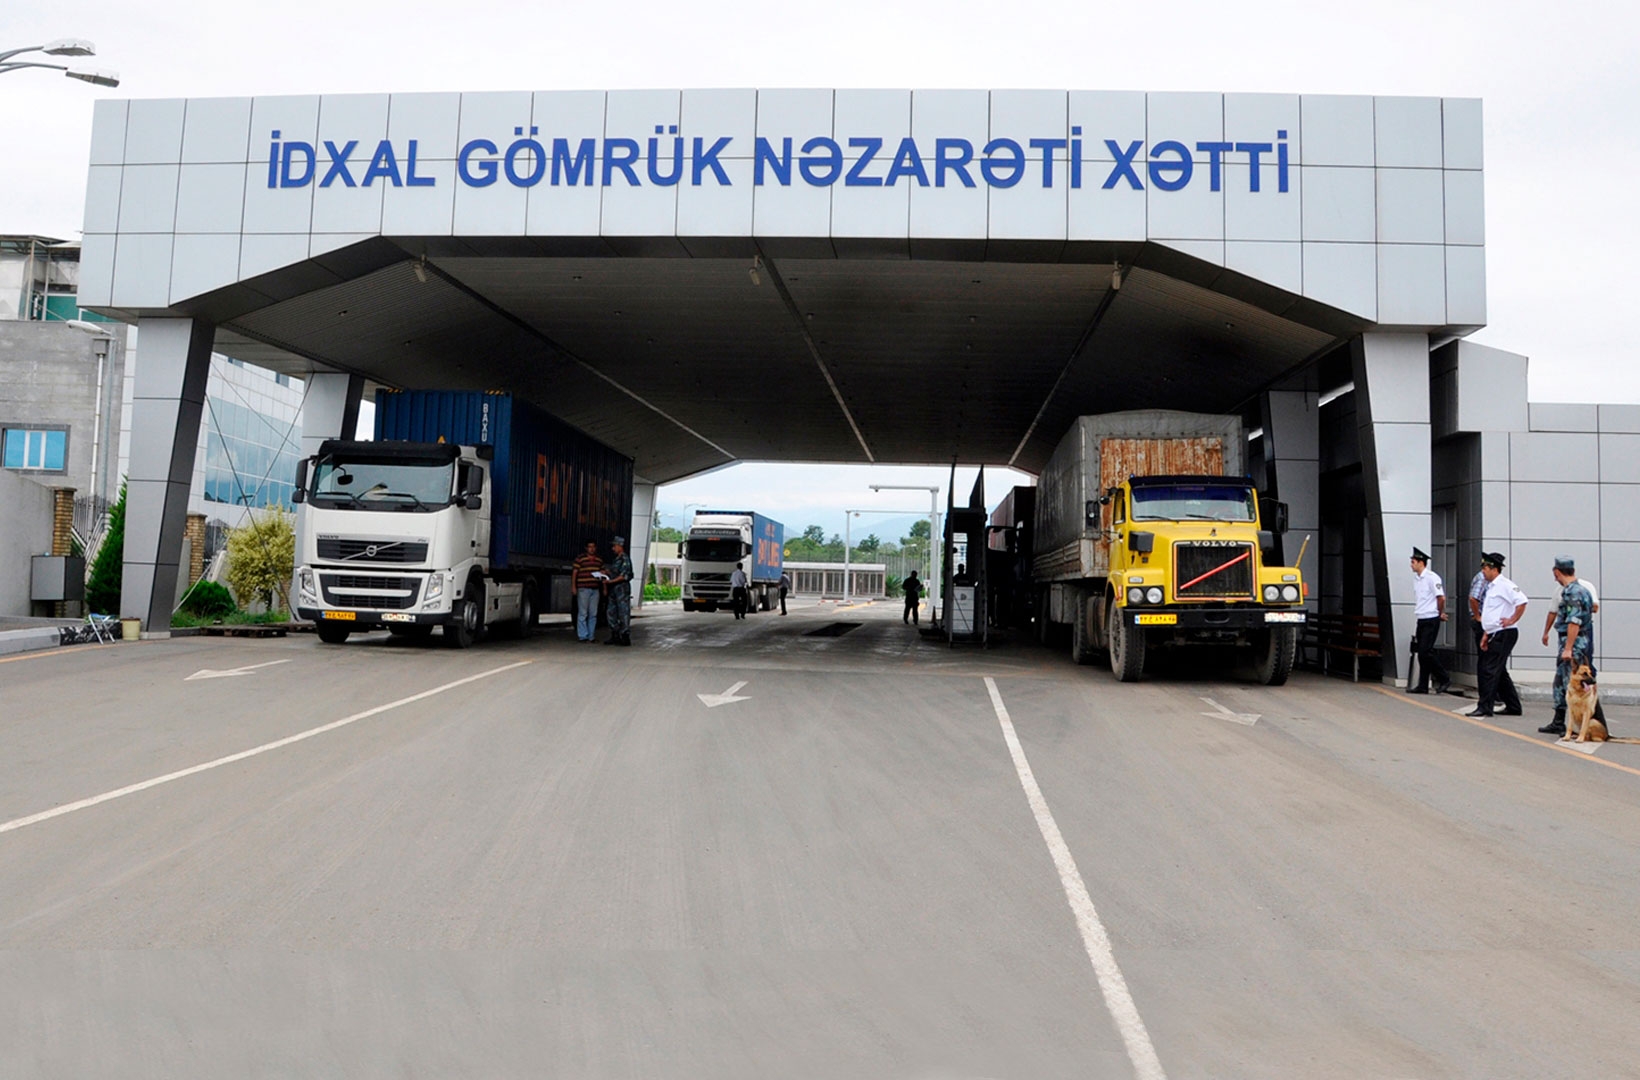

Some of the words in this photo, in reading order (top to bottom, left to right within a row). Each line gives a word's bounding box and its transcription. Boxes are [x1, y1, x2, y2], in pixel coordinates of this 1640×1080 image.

[268, 130, 435, 188] İDXAL
[457, 126, 733, 187] GÖMRÜK
[753, 126, 1082, 188] NƏZARƏTİ
[1102, 130, 1289, 193] XƏTTİ
[481, 403, 489, 442] BAXU
